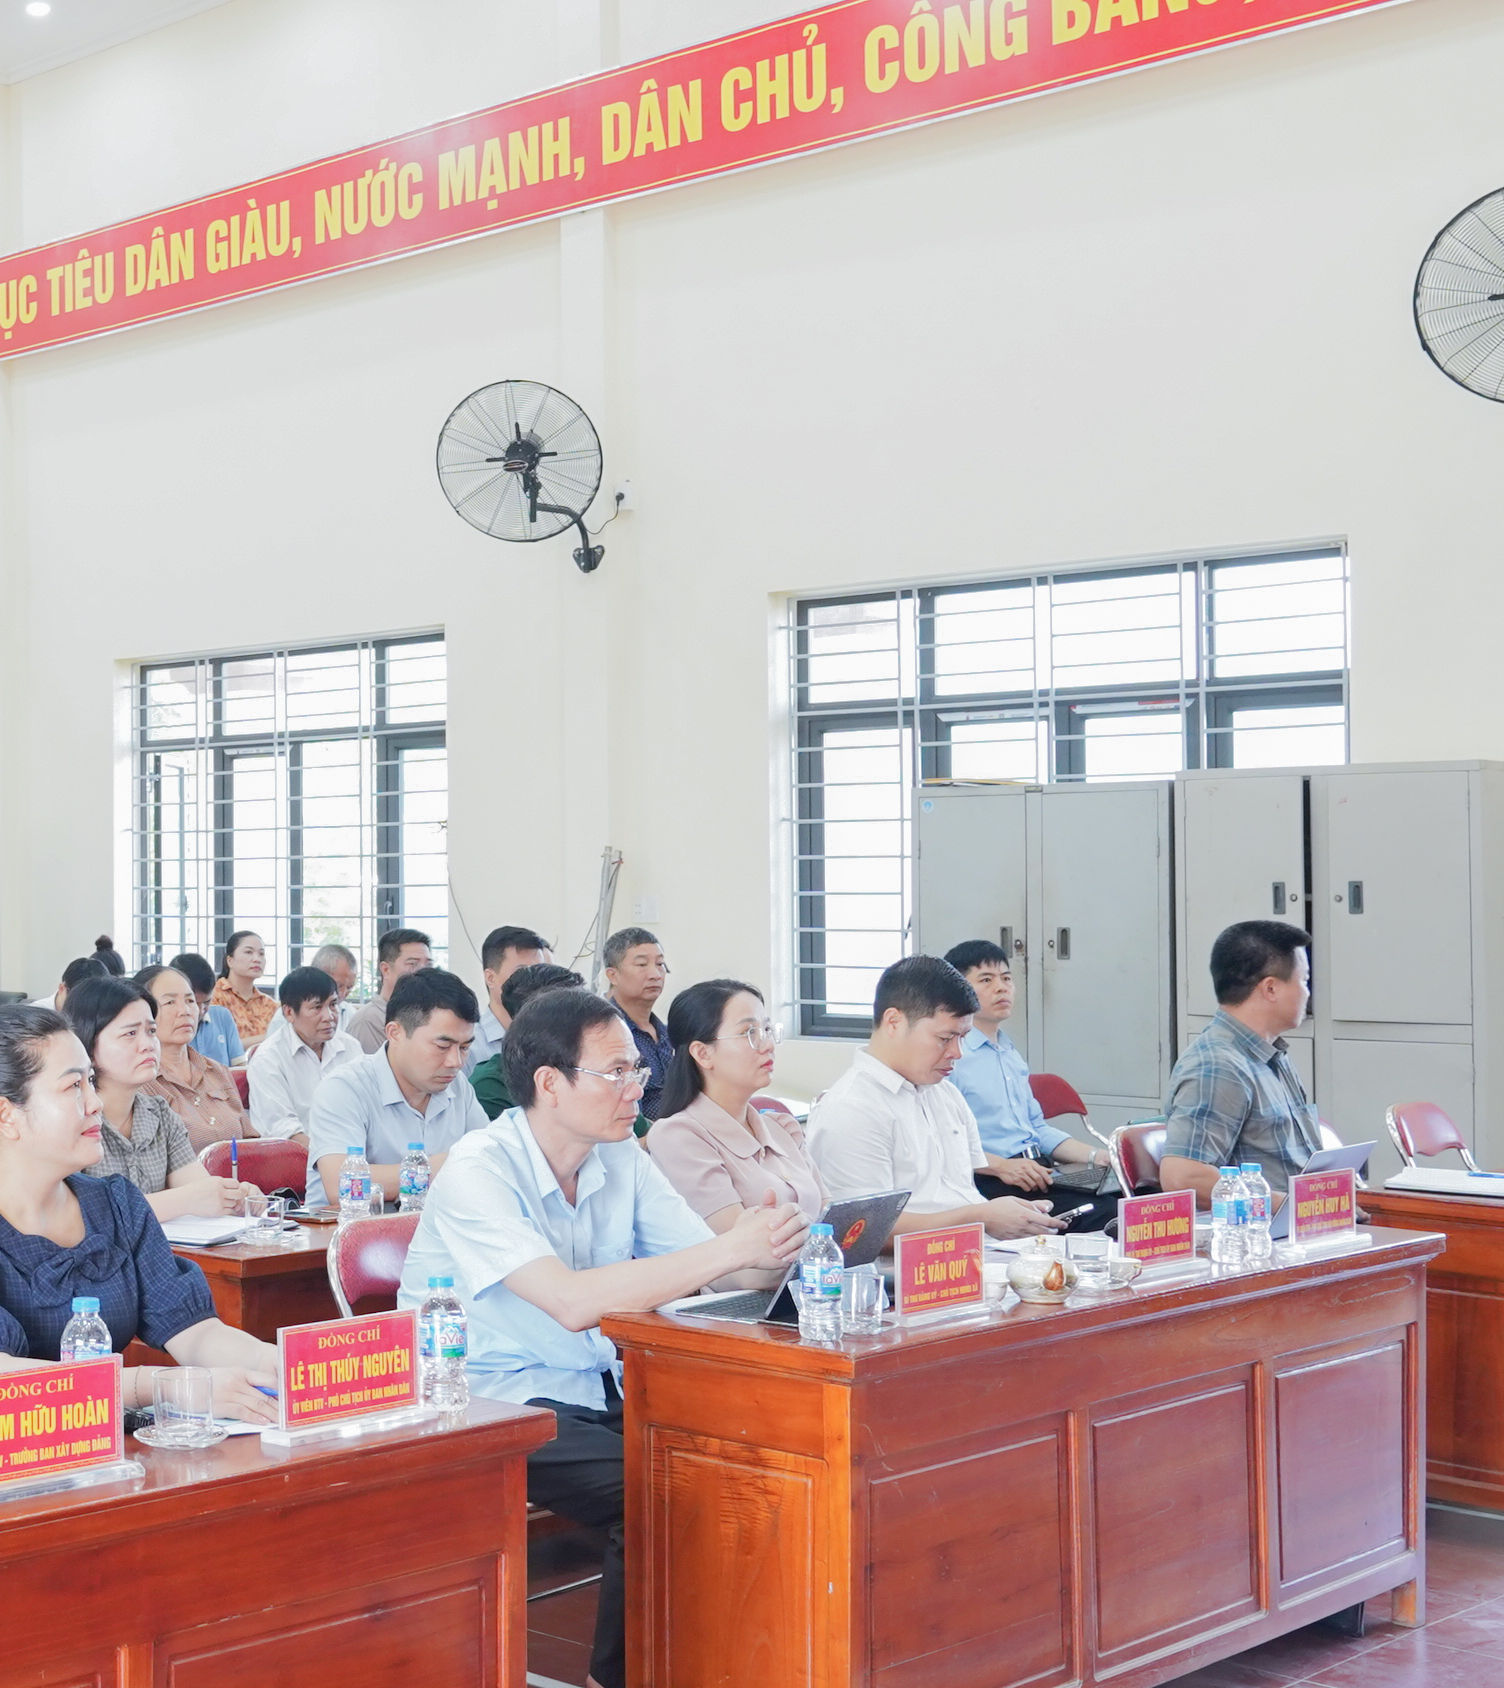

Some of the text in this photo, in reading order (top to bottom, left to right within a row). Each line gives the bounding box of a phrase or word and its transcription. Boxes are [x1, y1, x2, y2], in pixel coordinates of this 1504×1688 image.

[47, 249, 115, 317] TIÊU
[124, 228, 195, 298] DÂN
[205, 199, 302, 275] GIÀU,
[314, 172, 424, 246] NƯỚC
[438, 117, 586, 211] MẠNH,
[601, 78, 704, 165] DÂN
[719, 23, 844, 133] CHỦ,
[863, 0, 1029, 93] CÔNG
[914, 1254, 968, 1285] LÊ VĂN QUÝ
[318, 1325, 381, 1349] ĐỒNG CHÍ
[291, 1344, 410, 1391] LÊ THỊ THÚY NGUYÊN
[45, 1373, 74, 1394] CHÍ
[20, 1403, 56, 1438] HỮU
[61, 1395, 109, 1431] HOÀN
[39, 1446, 55, 1461] BAN
[56, 1441, 70, 1458] XÂY
